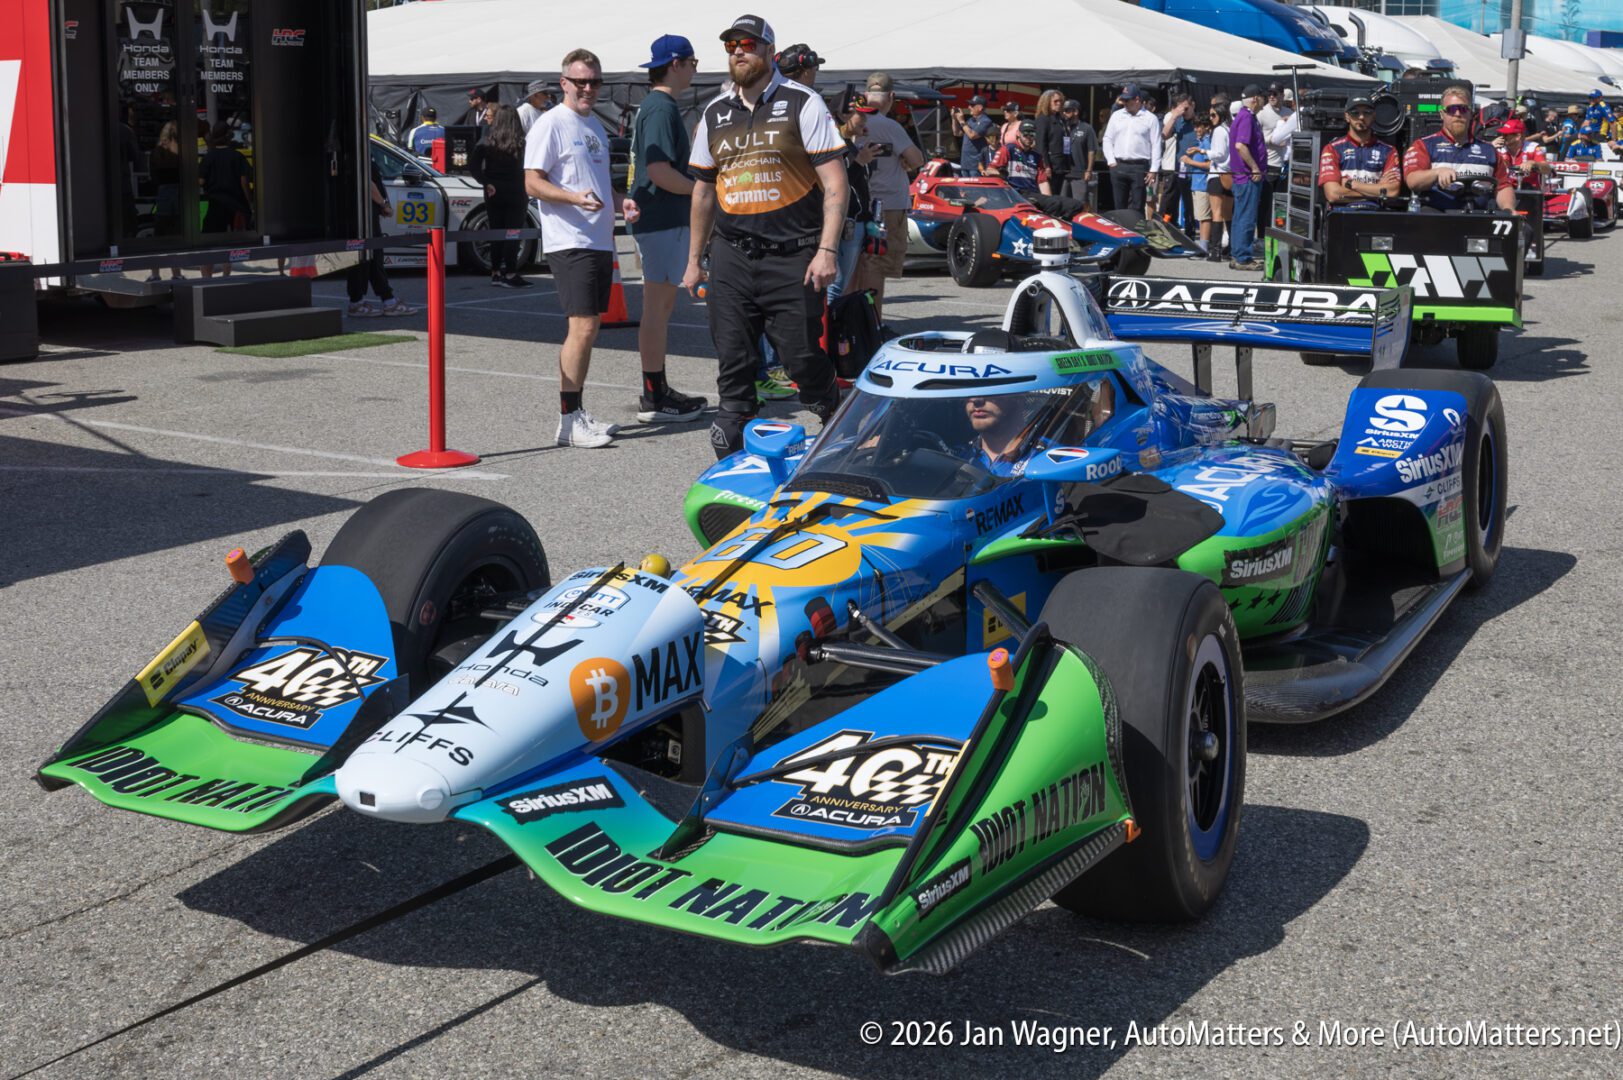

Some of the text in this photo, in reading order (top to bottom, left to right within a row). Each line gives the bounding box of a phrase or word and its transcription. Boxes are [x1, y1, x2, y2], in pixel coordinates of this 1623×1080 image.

[123, 44, 169, 53] Honda
[200, 45, 242, 54] Honda
[133, 58, 159, 67] TEAM
[210, 59, 234, 68] TEAM
[123, 70, 170, 80] MEMBERS
[200, 71, 243, 81] MEMBERS
[135, 83, 159, 93] ONLY
[211, 84, 234, 93] ONLY
[717, 131, 780, 155] AULT
[754, 171, 782, 183] BULLS
[402, 202, 429, 223] 93
[1492, 220, 1513, 235] 77
[1152, 284, 1386, 319] ACURA
[873, 359, 1012, 378] ACURA
[975, 490, 1025, 536] REMAX
[1230, 547, 1293, 578] SiriusXM
[568, 567, 670, 594] SirisXM
[543, 600, 615, 617] INDCAR
[163, 640, 199, 676] Clopay
[632, 631, 703, 712] MAX
[245, 692, 316, 712] ANNIVERSARY
[238, 704, 311, 725] ACURA
[66, 745, 301, 813] IDIOT NATI
[508, 782, 614, 814] SiriusXM
[810, 795, 904, 815] ANNIVERSARY
[808, 807, 903, 826] ACURA
[969, 760, 1107, 877] IDIOT NATION
[545, 820, 694, 902] IDIOT
[918, 864, 970, 910] SiriusXM
